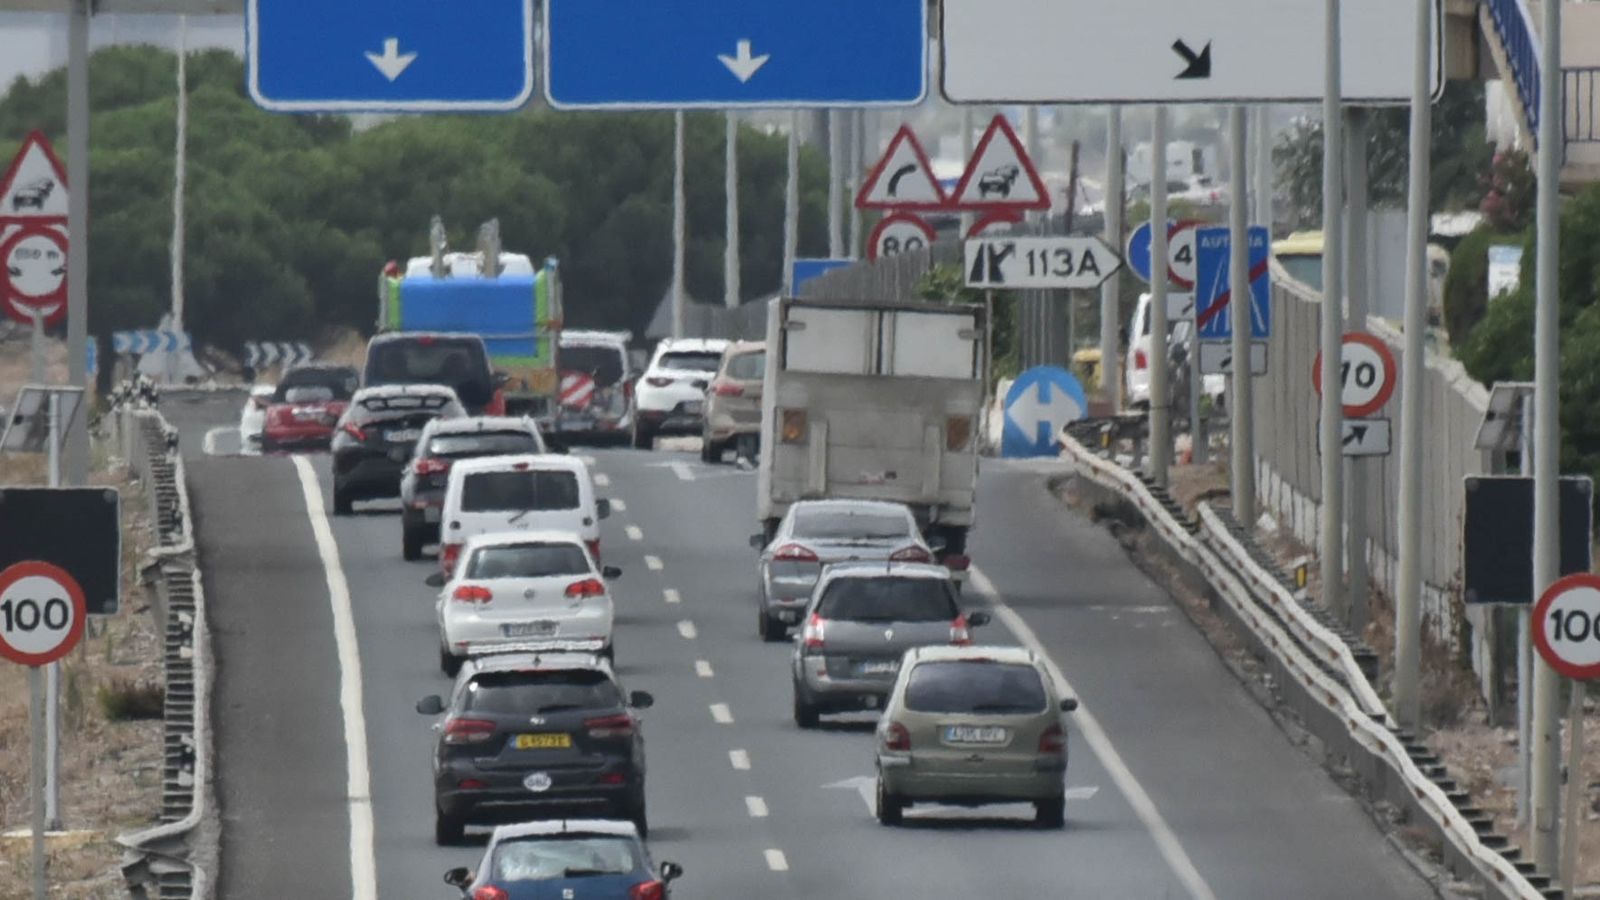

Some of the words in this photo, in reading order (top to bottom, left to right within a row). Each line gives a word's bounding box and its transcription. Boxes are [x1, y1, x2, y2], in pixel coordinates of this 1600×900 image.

[1201, 235, 1263, 249] AUTIA
[1026, 248, 1101, 277] 113A
[1, 598, 69, 632] 100
[1550, 608, 1600, 643] 10
